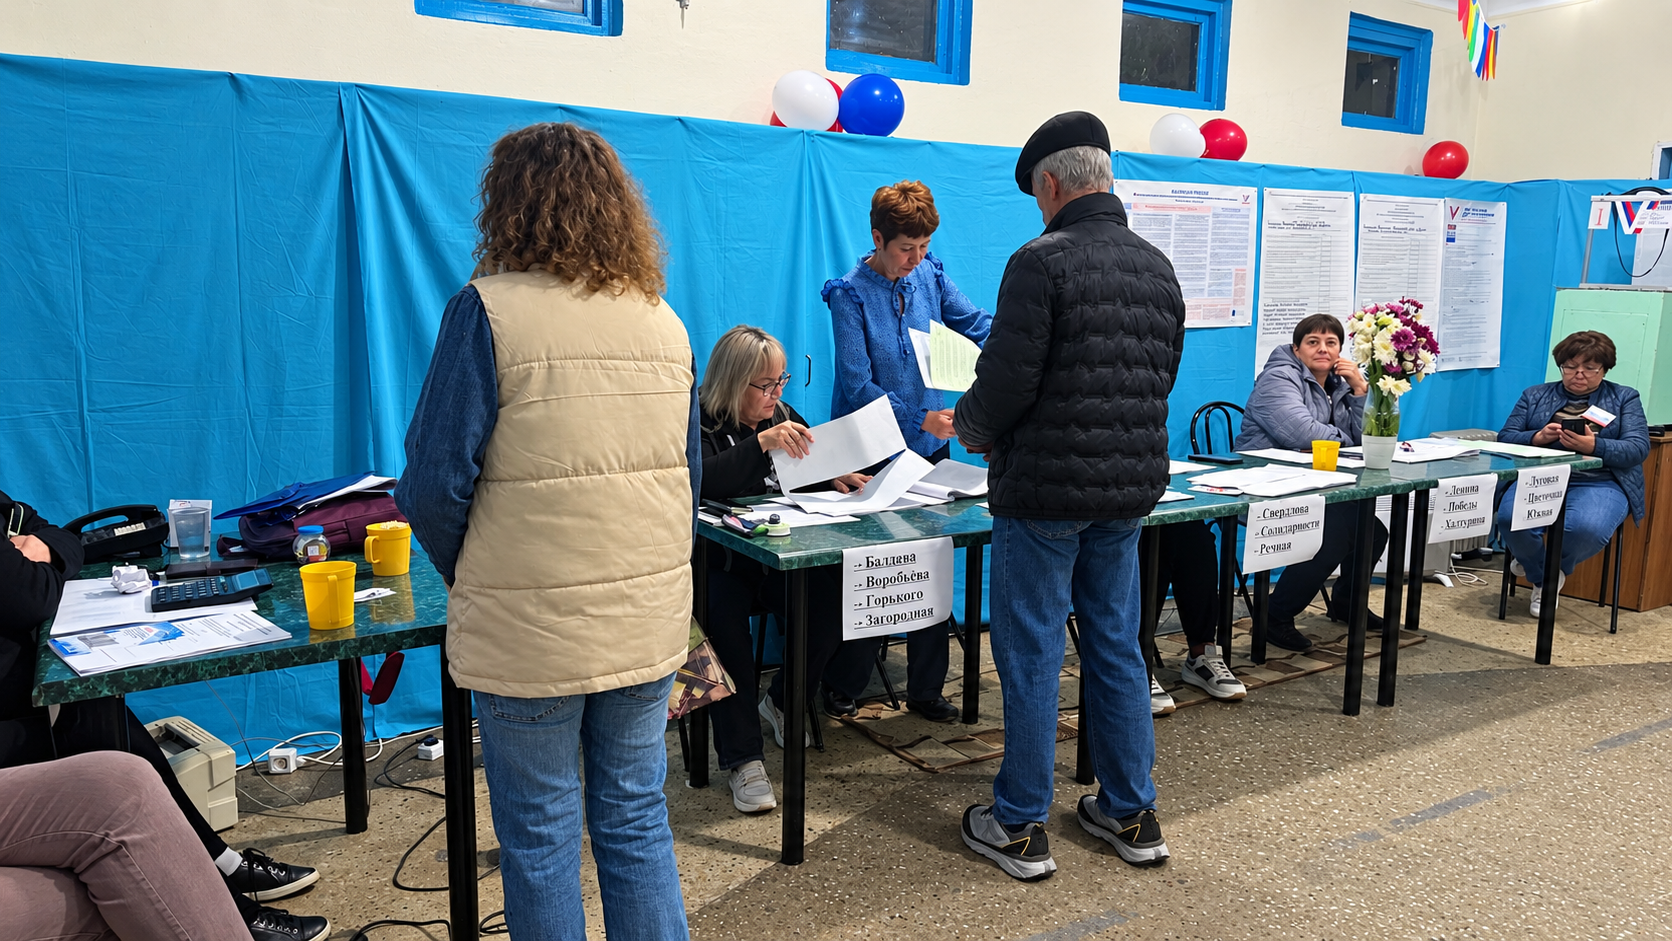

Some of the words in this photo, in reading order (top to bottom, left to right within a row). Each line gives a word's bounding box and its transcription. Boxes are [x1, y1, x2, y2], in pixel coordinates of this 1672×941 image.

[1449, 485, 1479, 495] Ленина
[1262, 505, 1309, 519] Свердлова
[1448, 500, 1478, 512] Победы
[1260, 520, 1320, 537] Солидарности
[1445, 516, 1486, 529] Халтурина
[1260, 541, 1292, 555] Речная
[866, 570, 930, 589] Воробьёва
[866, 590, 924, 608] Горького
[865, 607, 934, 626] Загородная
